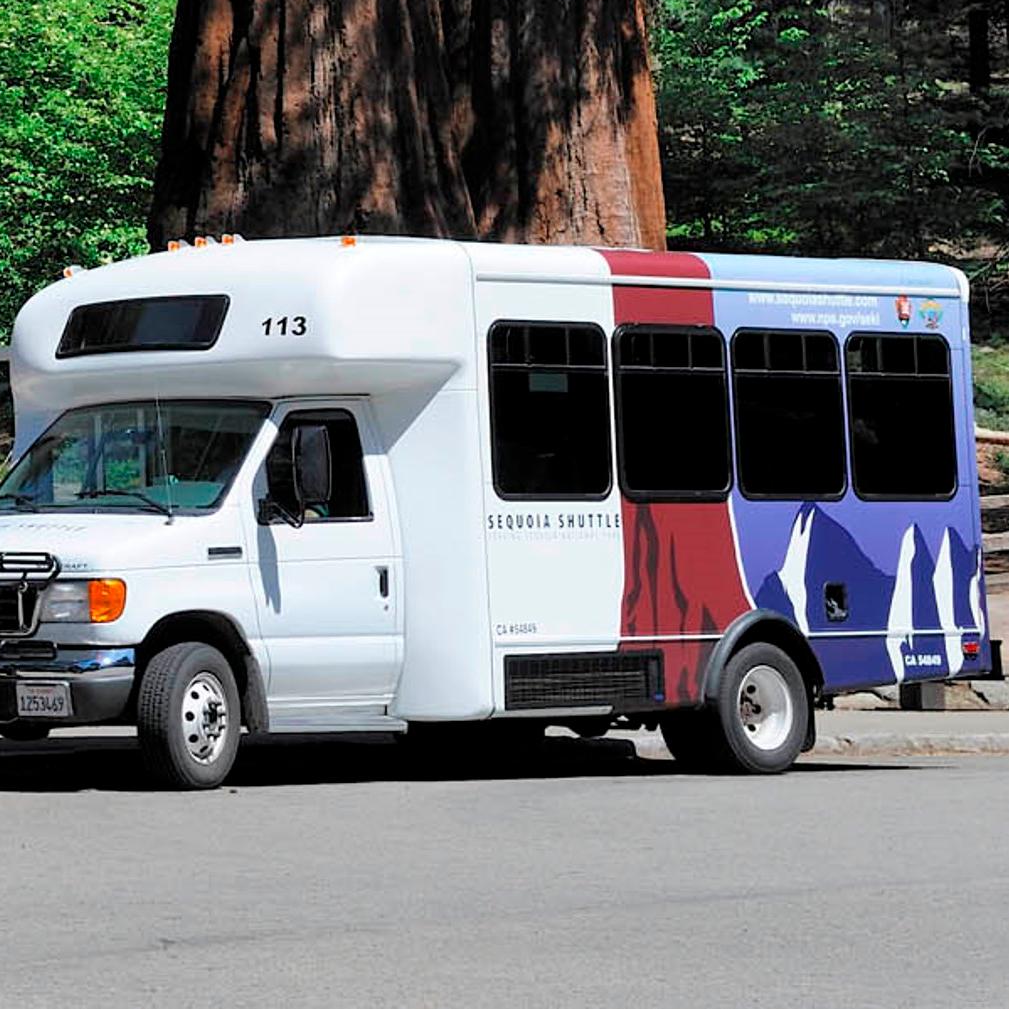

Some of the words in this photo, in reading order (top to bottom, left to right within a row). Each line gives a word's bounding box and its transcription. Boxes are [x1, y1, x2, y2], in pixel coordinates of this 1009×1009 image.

[261, 316, 307, 336] 113
[487, 514, 551, 530] SEQUOIA
[558, 514, 620, 528] SHUTTLE
[496, 624, 507, 636] CA
[904, 654, 916, 667] CA
[20, 695, 64, 712] 1253469
